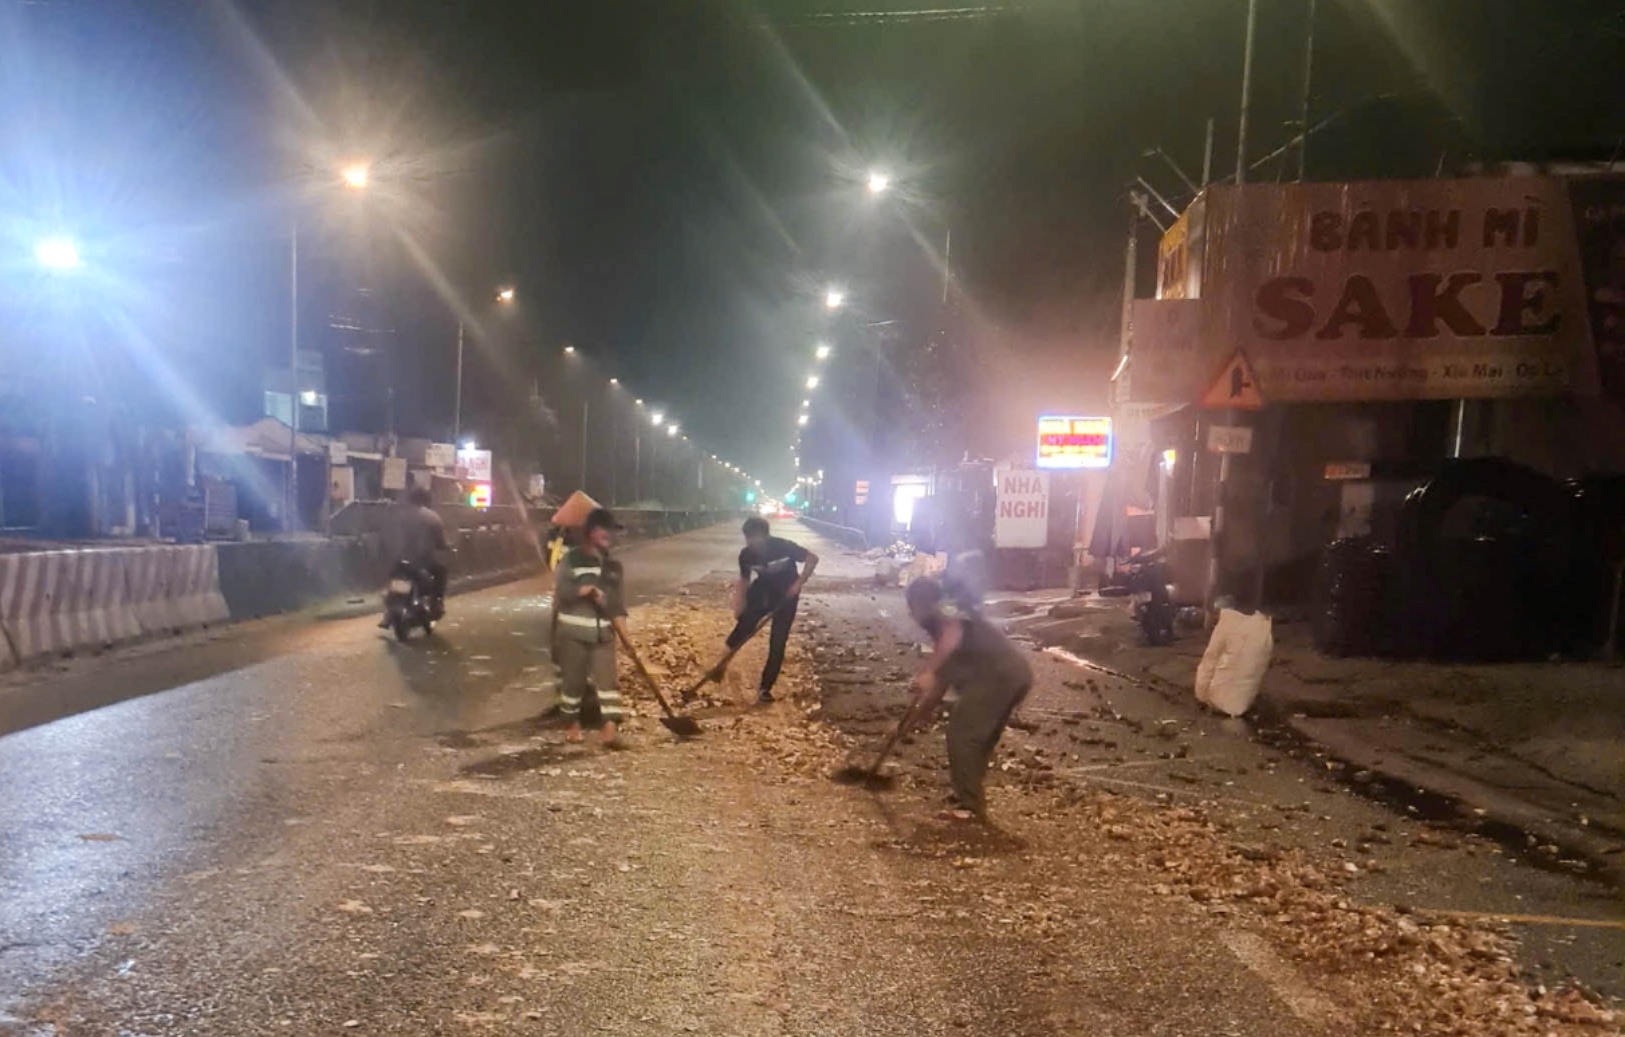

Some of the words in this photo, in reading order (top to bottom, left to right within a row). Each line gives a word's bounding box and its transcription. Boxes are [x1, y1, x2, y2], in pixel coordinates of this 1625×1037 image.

[1483, 195, 1546, 248] MÌ
[1253, 272, 1563, 341] SAKE
[1000, 494, 1046, 518] NGHỈ
